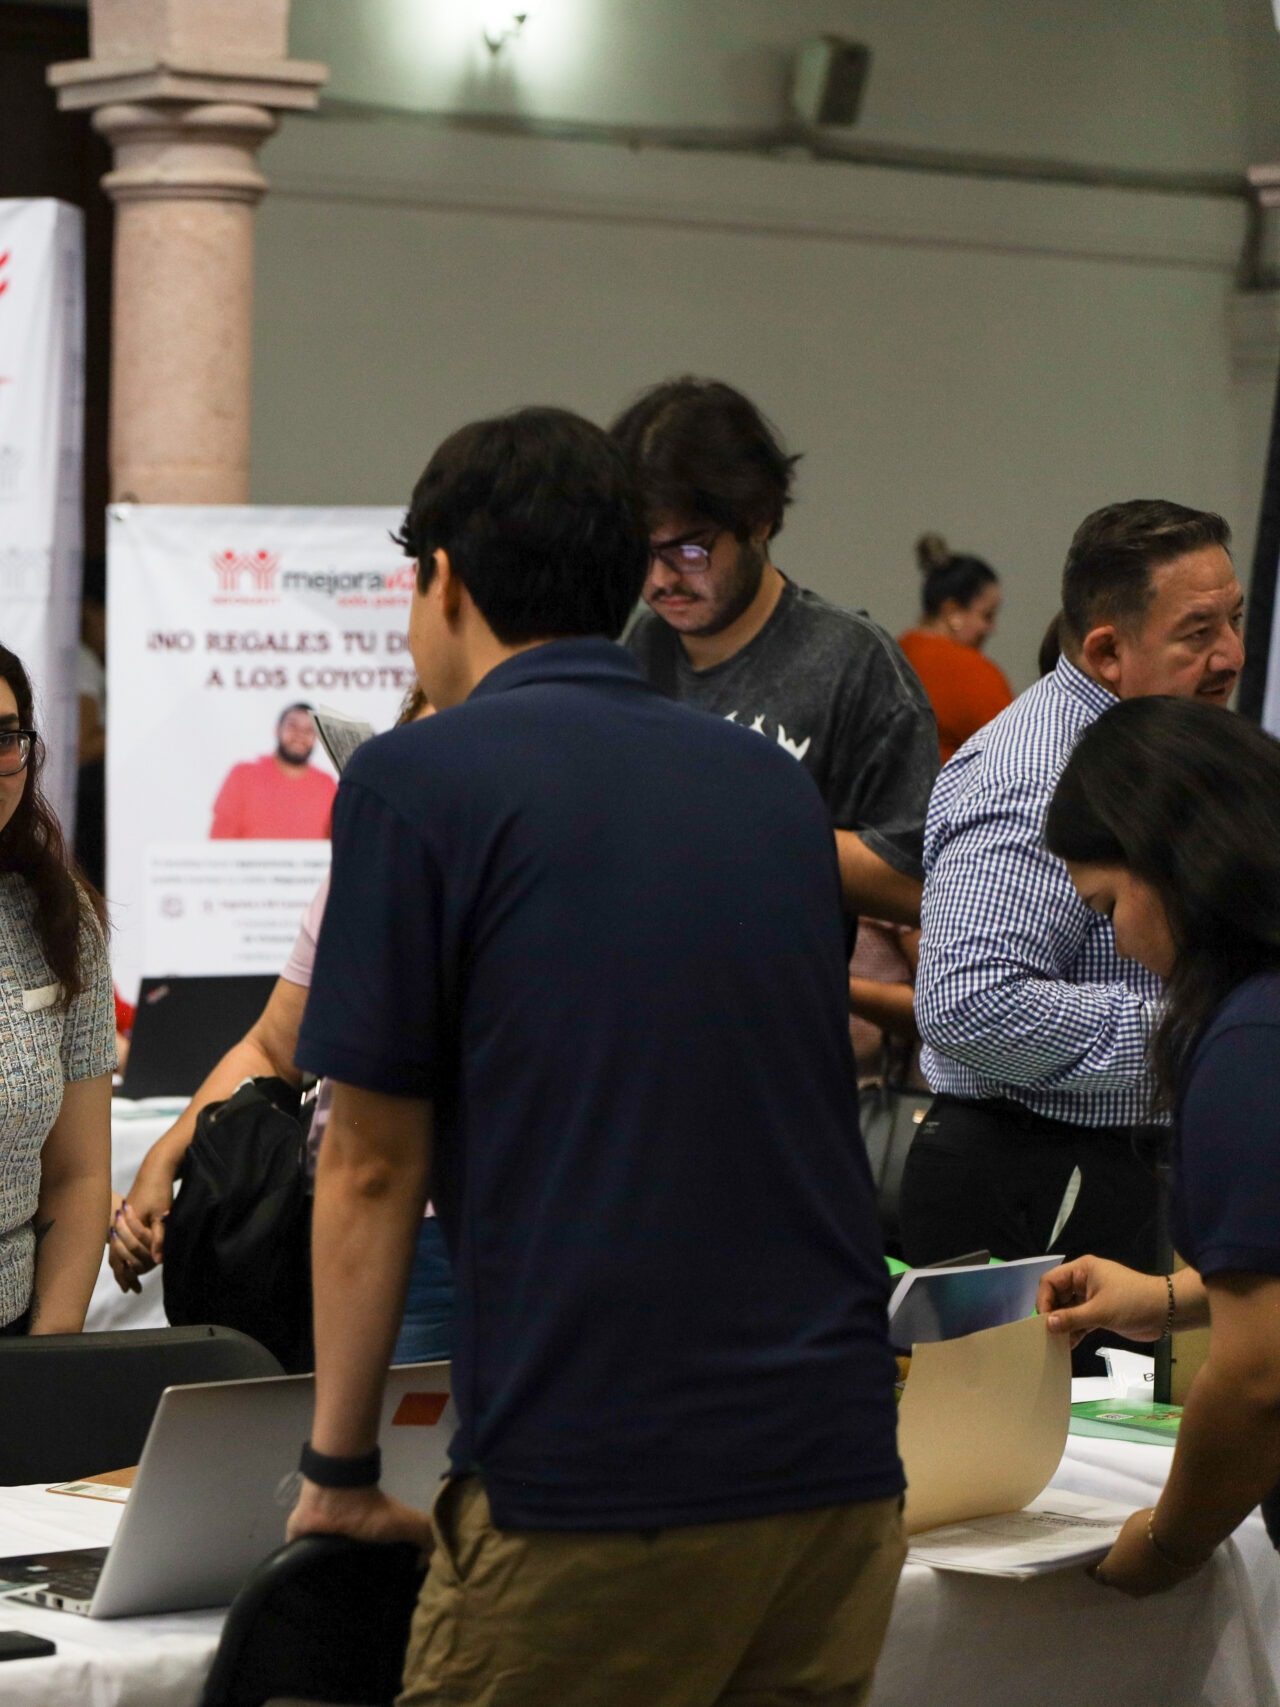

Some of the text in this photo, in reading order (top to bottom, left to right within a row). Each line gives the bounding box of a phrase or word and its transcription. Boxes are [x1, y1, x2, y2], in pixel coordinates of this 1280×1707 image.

[206, 631, 330, 652] REGALES
[344, 631, 377, 652] TU
[205, 669, 222, 688] A
[235, 669, 288, 688] LOS
